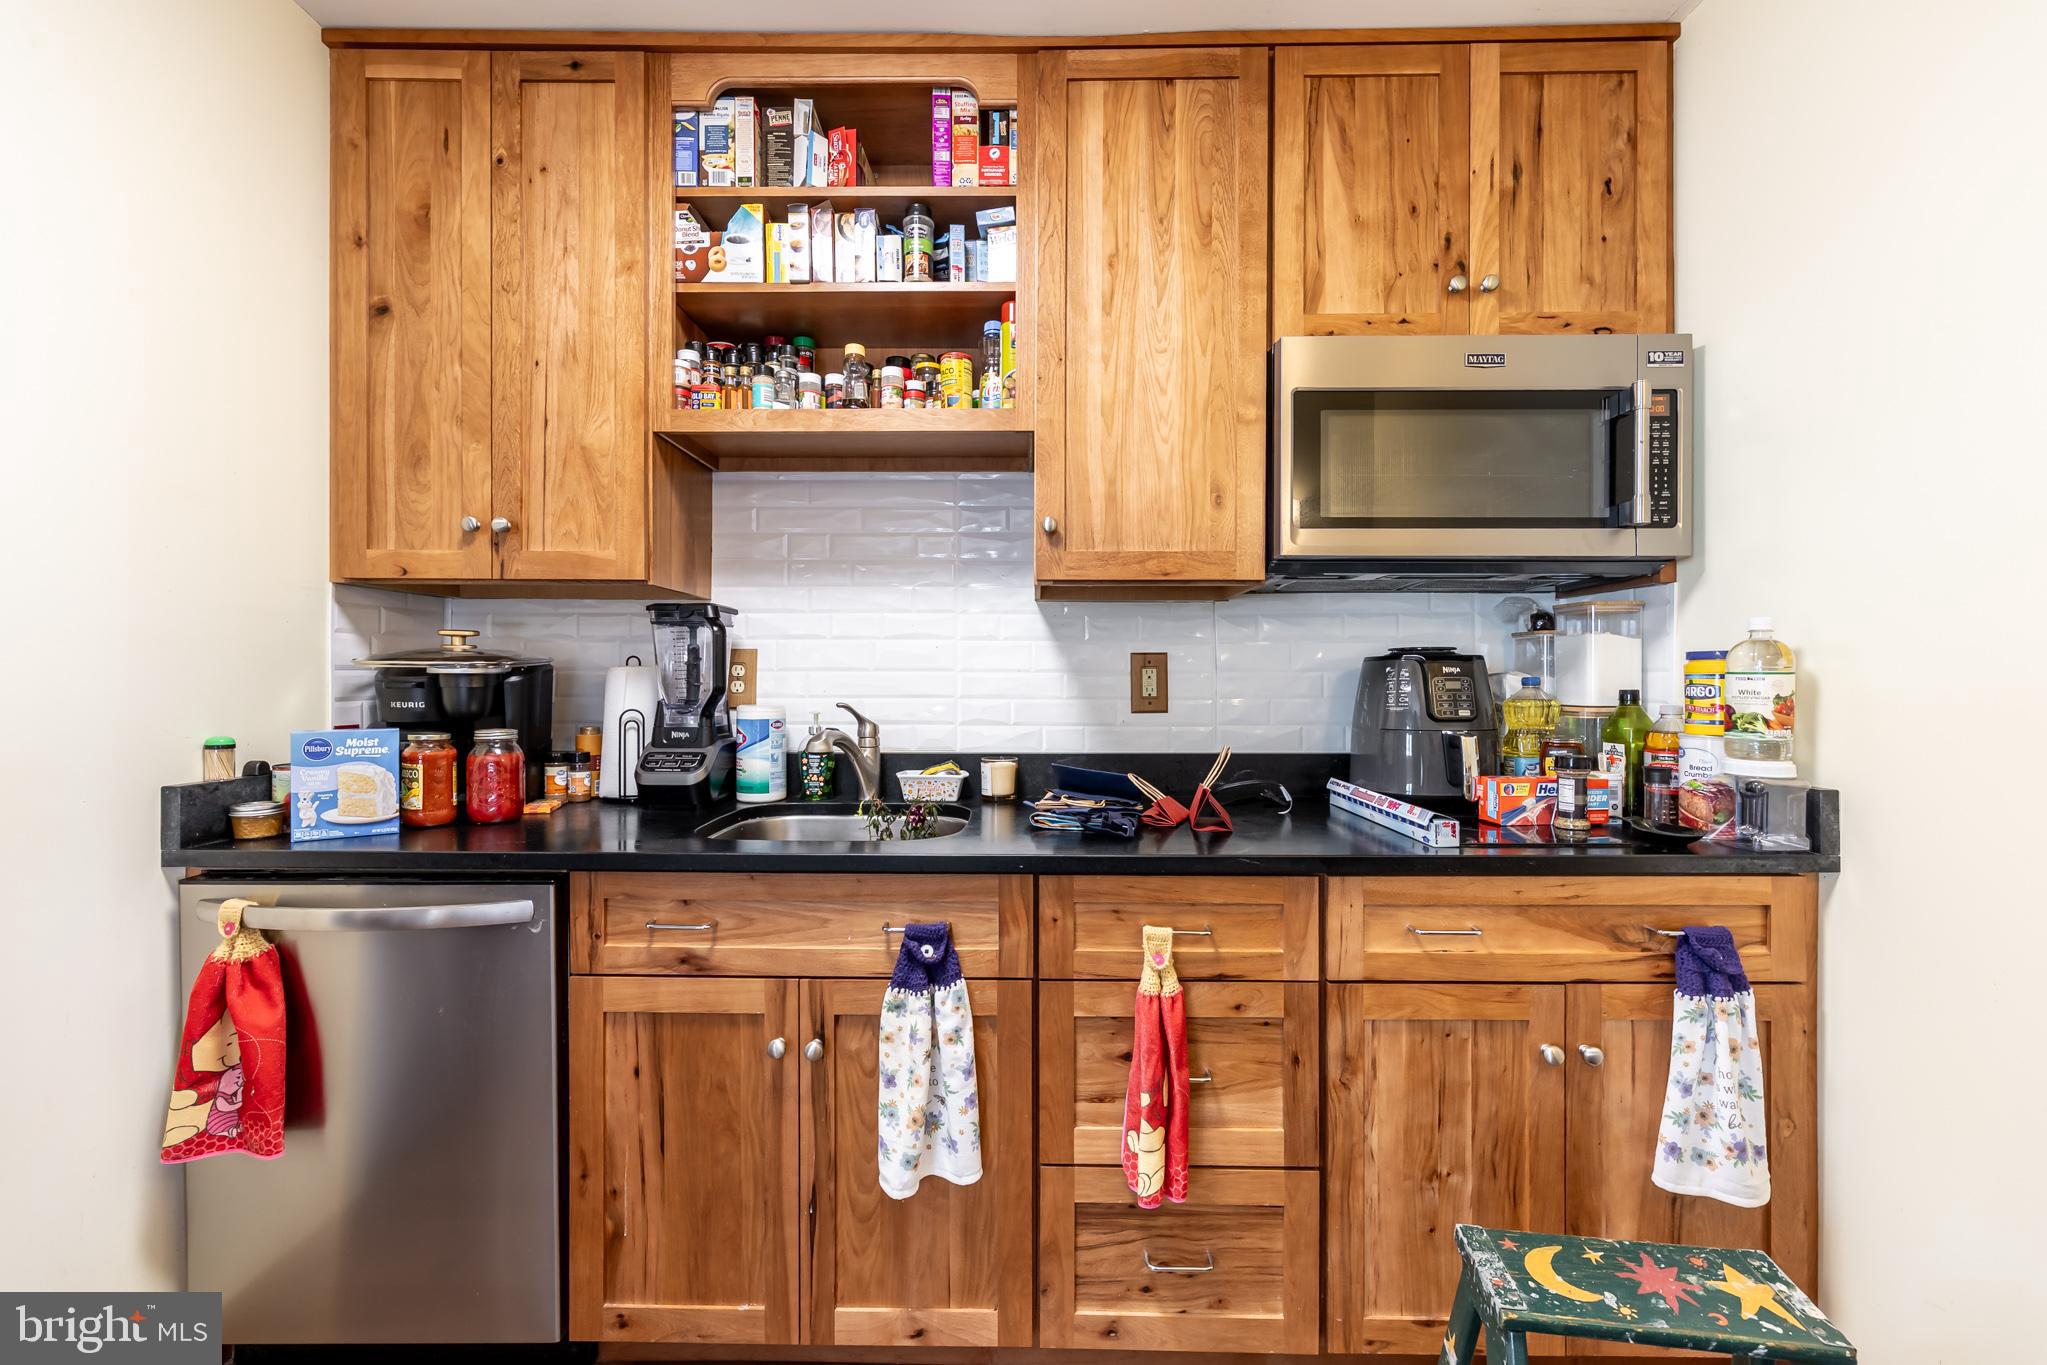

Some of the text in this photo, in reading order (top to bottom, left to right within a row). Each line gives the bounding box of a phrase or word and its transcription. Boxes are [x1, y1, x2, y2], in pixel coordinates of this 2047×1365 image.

[771, 113, 790, 121] PENNE
[1468, 355, 1504, 363] MAYTAG
[1649, 352, 1664, 361] 10
[1442, 666, 1461, 674] NINJA
[1685, 685, 1715, 697] ARGO
[671, 731, 690, 739] NINJA
[346, 737, 379, 747] Moist
[304, 745, 332, 753] Pillsbury
[335, 746, 389, 757] Supreme
[1689, 764, 1713, 772] Bread
[1728, 1113, 1742, 1129] be
